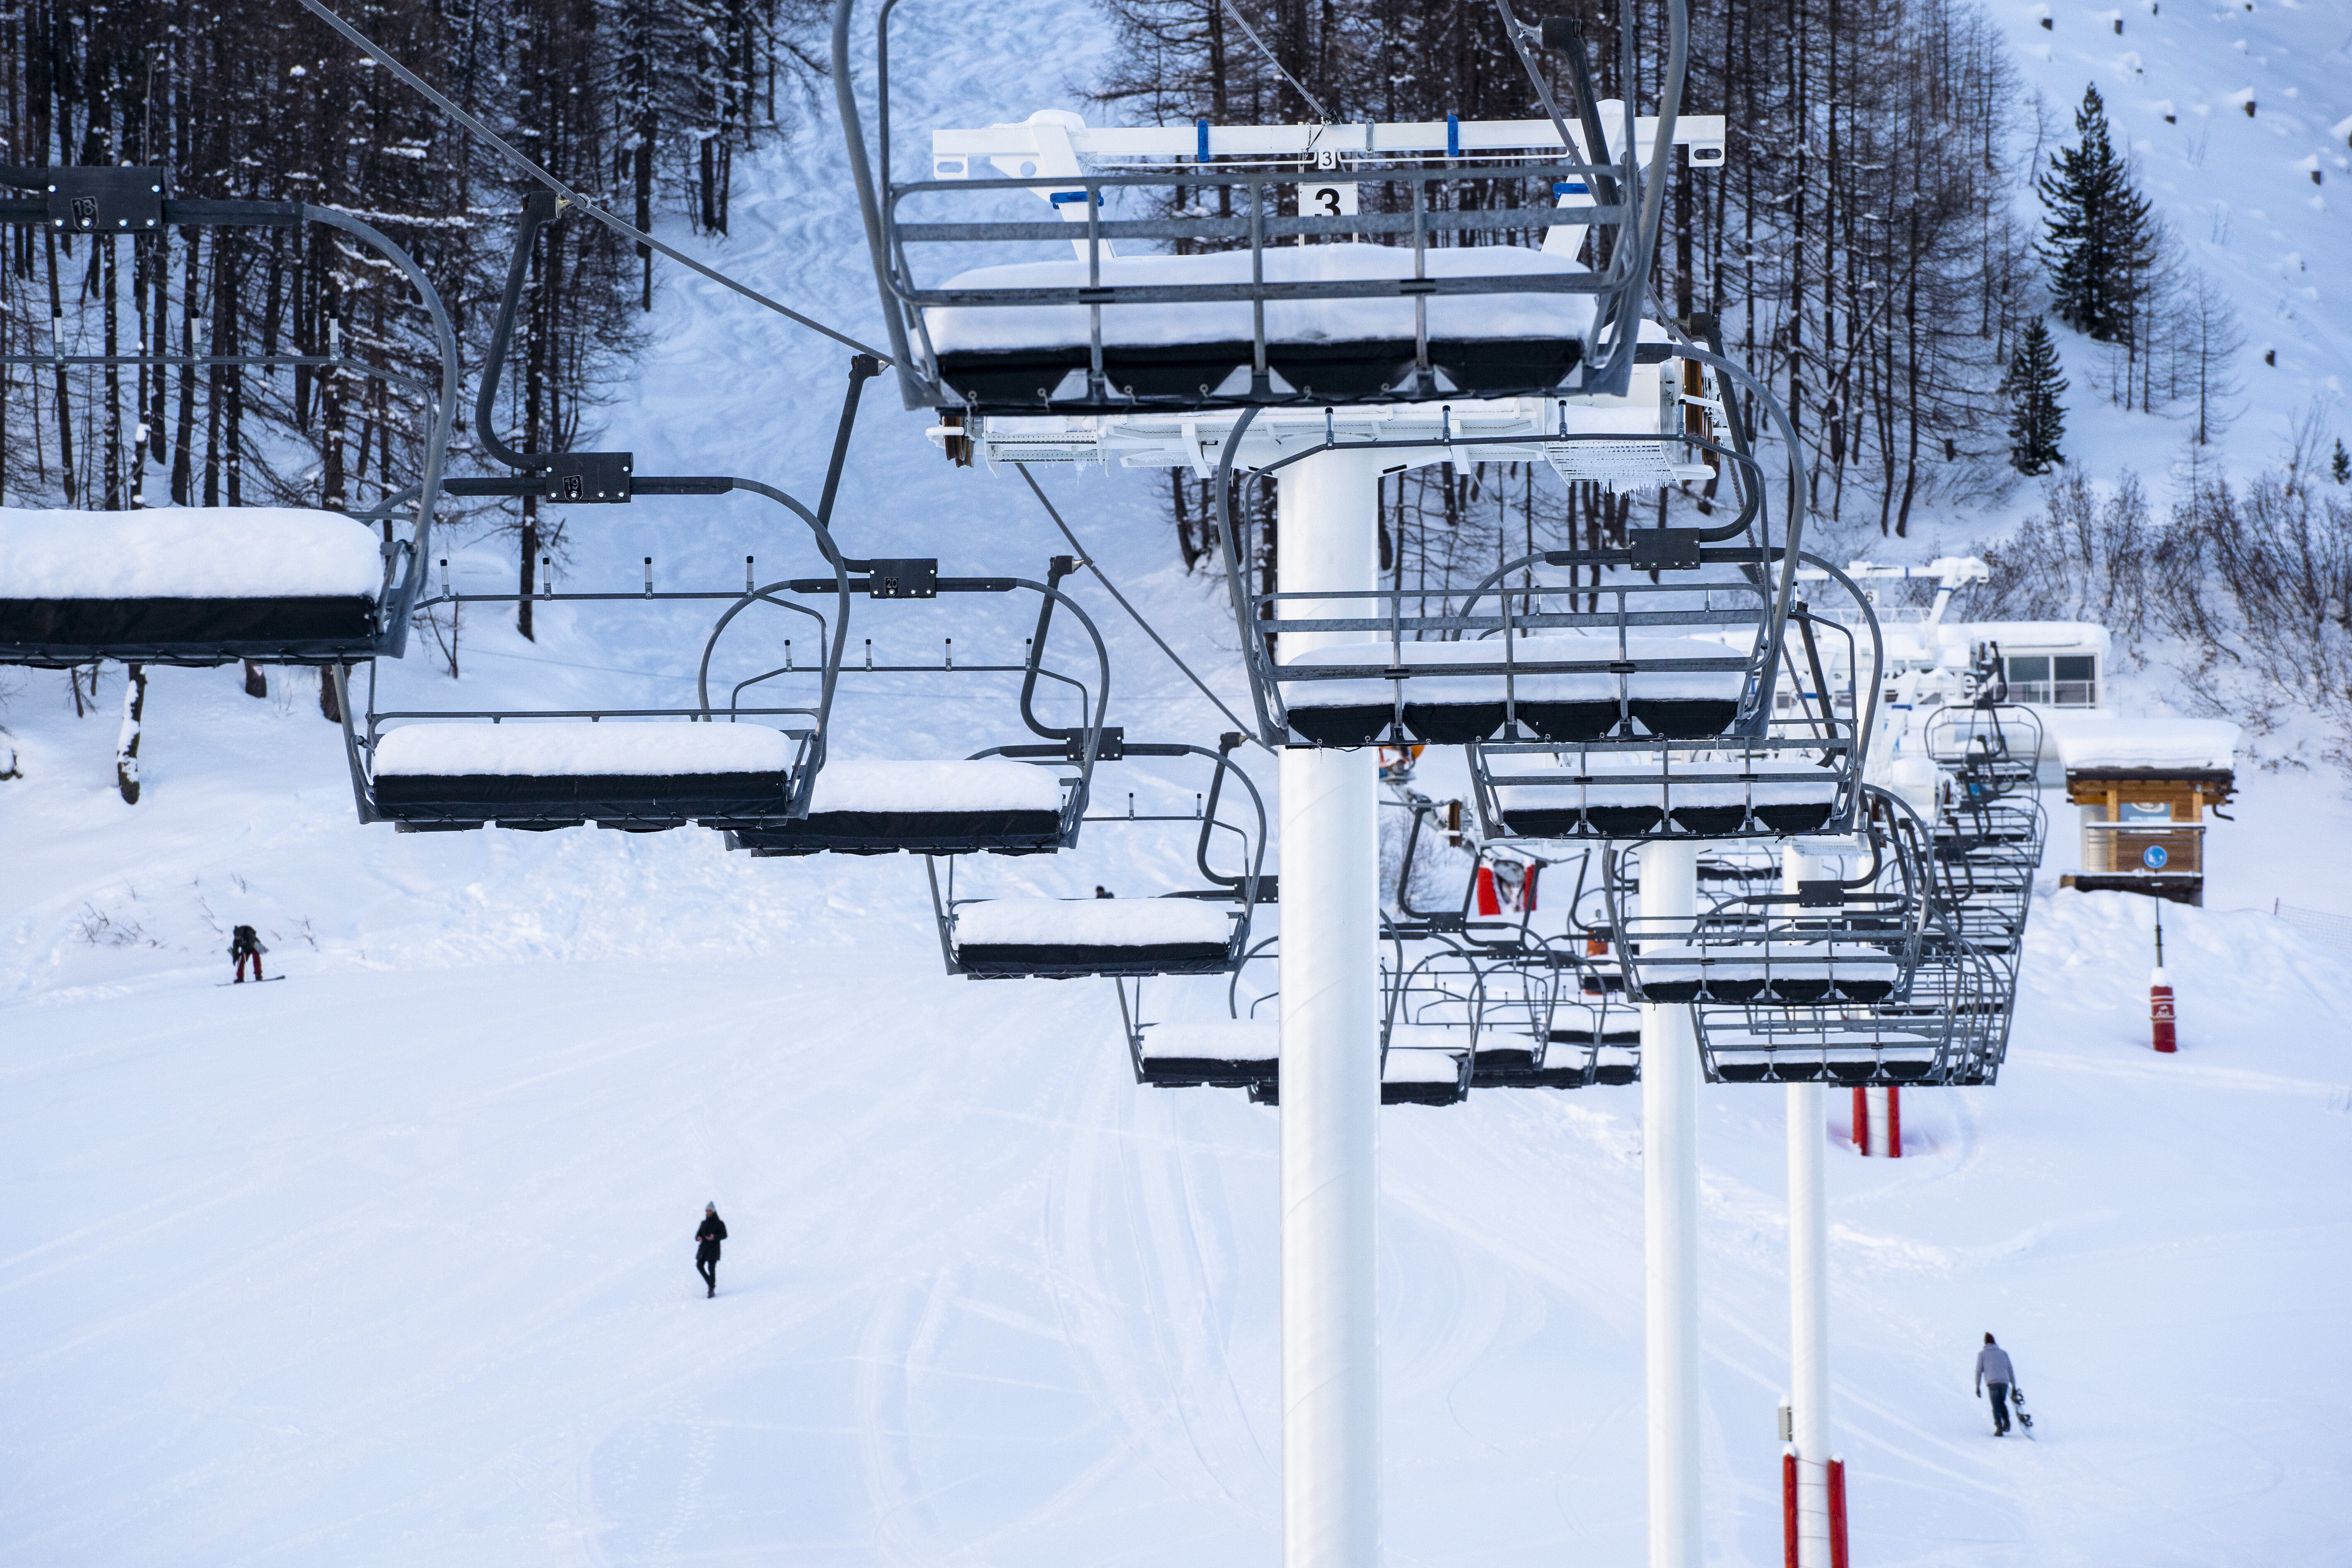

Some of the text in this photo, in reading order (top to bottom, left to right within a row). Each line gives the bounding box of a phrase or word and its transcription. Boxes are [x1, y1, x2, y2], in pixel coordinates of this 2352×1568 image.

[1322, 152, 1332, 167] 3
[75, 199, 94, 215] 18
[1315, 188, 1341, 217] 3
[565, 477, 579, 490] 19
[886, 578, 897, 588] 20
[1865, 591, 1873, 603] 6
